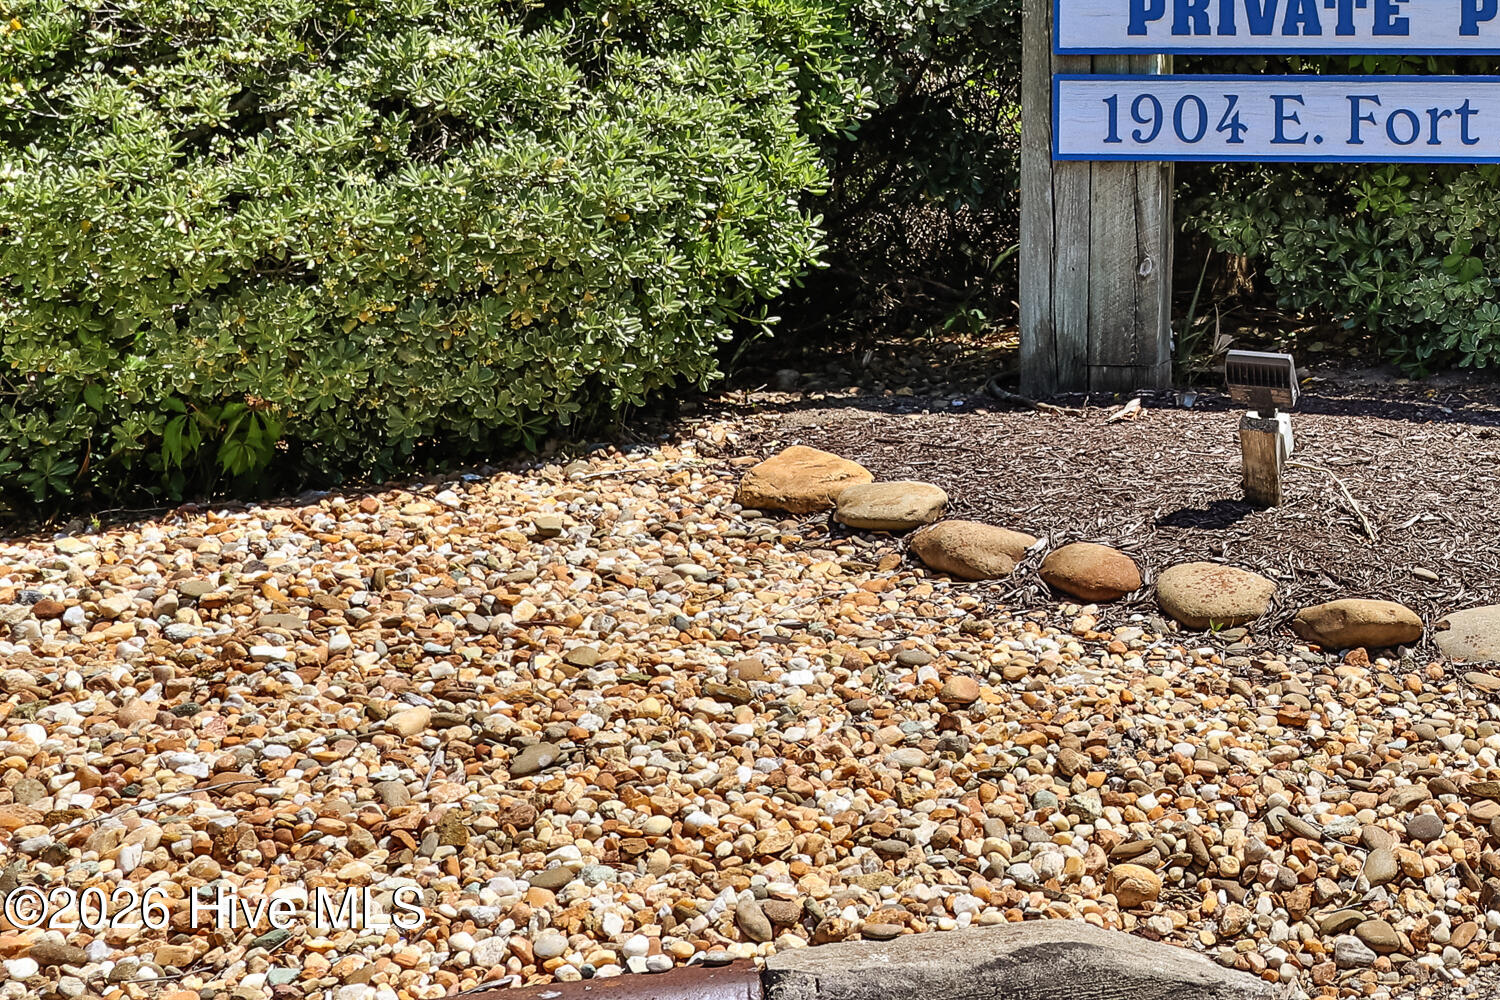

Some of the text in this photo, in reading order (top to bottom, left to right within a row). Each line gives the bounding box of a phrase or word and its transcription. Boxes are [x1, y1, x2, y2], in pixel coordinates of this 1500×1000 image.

[1101, 93, 1247, 146] 1904
[1269, 93, 1324, 146] E.
[1345, 92, 1480, 147] Fort
